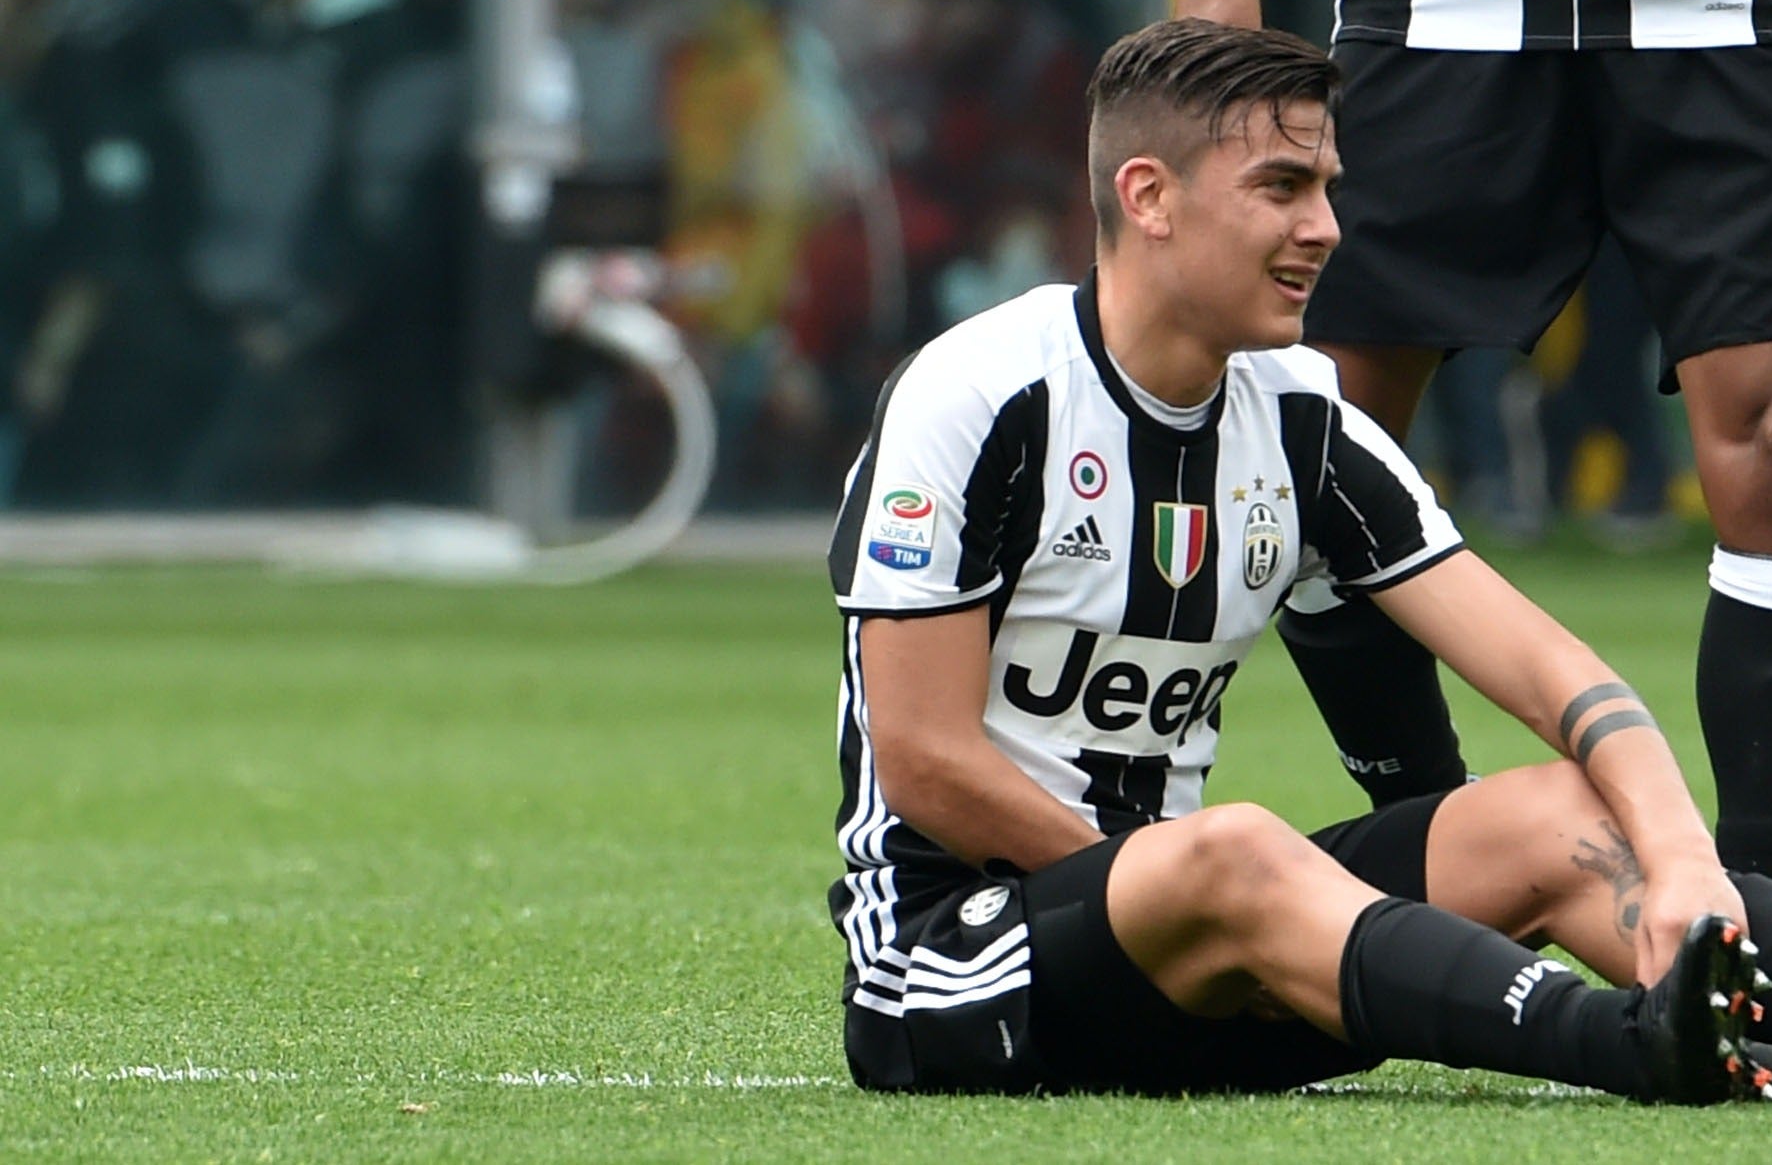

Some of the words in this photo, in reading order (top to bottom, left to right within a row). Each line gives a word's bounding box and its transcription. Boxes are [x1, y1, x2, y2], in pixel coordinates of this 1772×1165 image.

[880, 524, 913, 541] SERIE
[914, 531, 924, 543] A
[893, 548, 922, 566] TIM
[1052, 542, 1111, 562] adidas
[1003, 630, 1239, 748] Jeep
